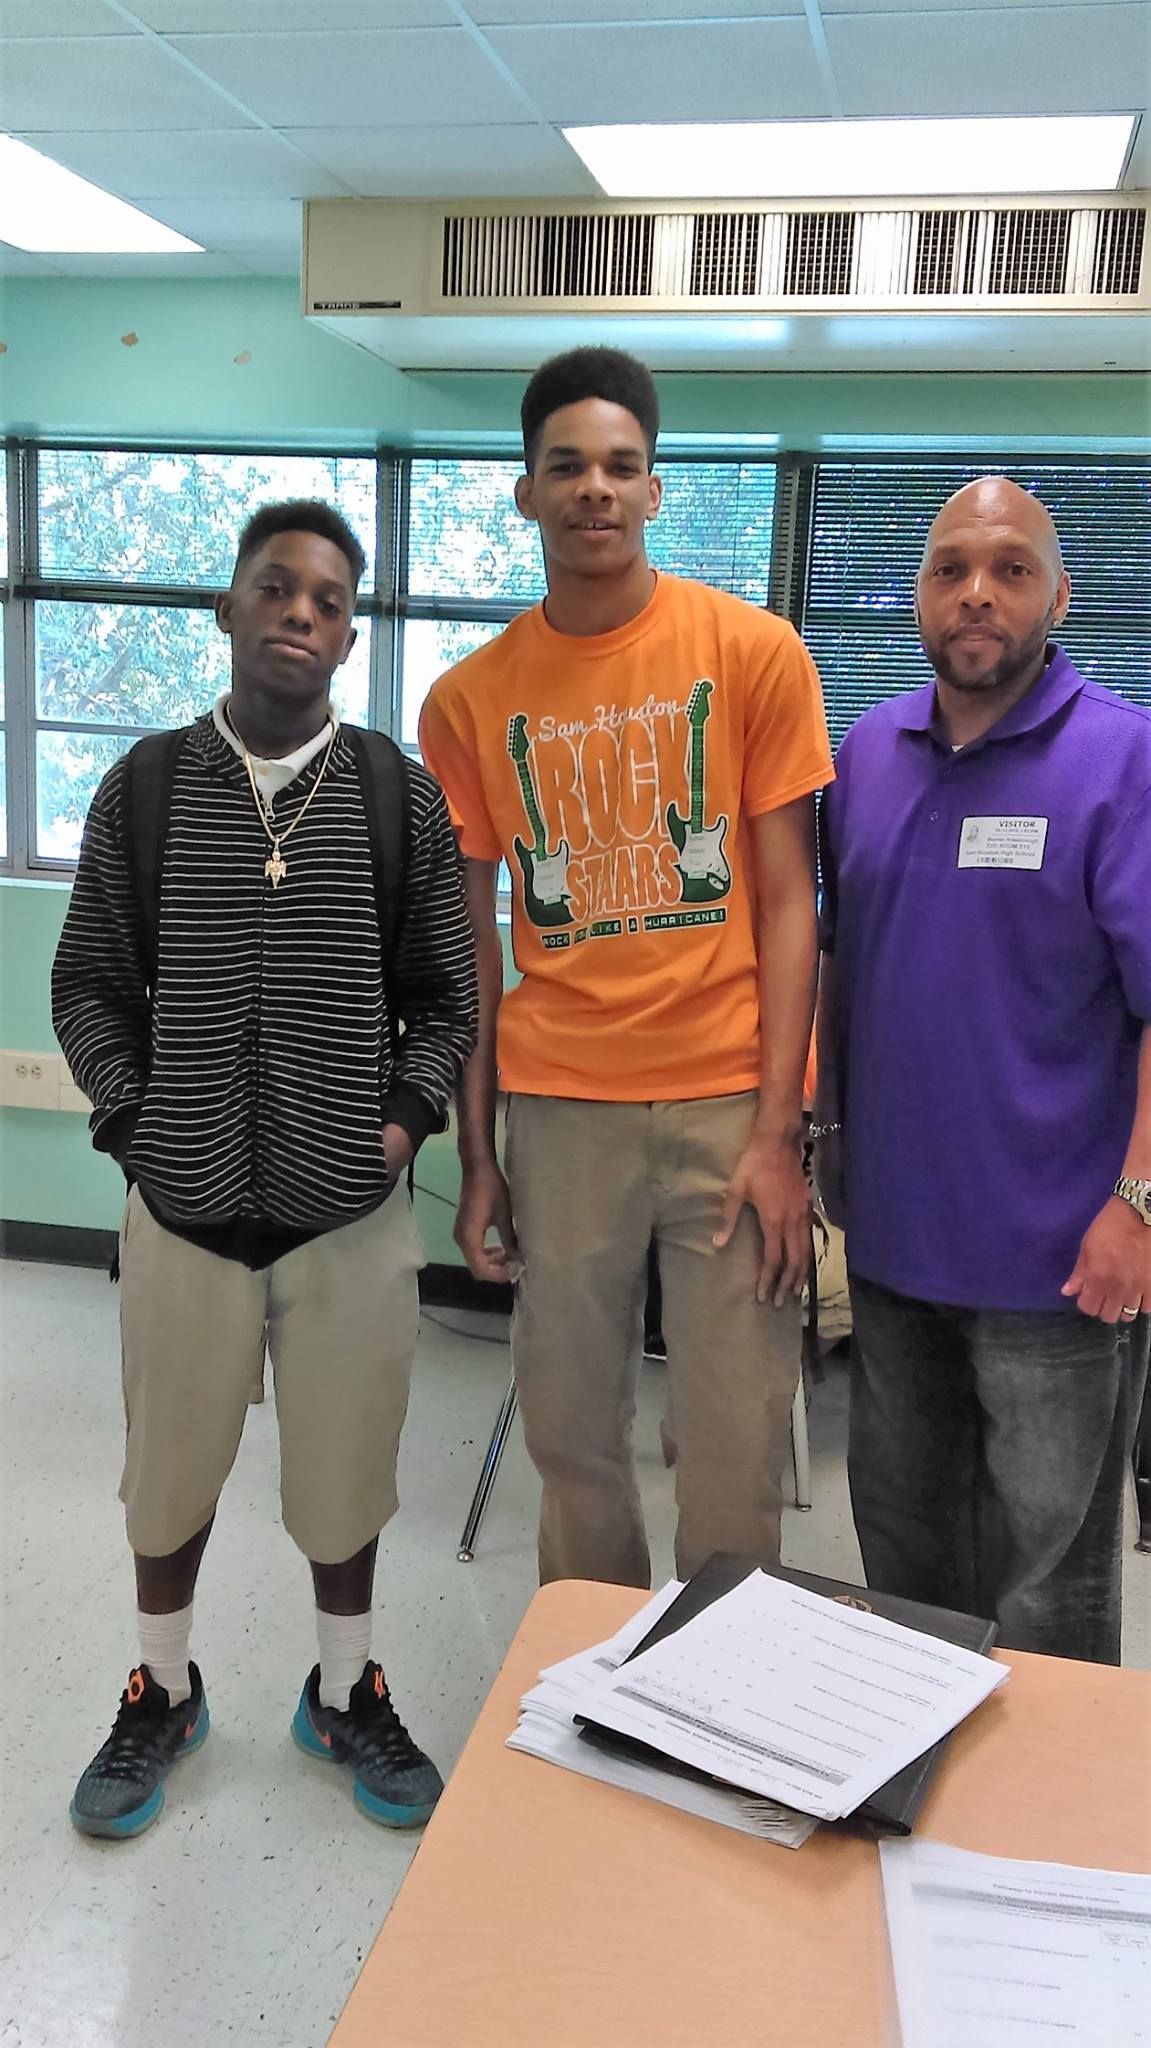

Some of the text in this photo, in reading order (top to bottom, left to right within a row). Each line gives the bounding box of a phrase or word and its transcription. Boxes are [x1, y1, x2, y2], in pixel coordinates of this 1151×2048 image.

[539, 716, 588, 742] Sam
[531, 713, 692, 855] ROCK
[999, 820, 1036, 828] VISITOR
[543, 935, 569, 948] ROCK
